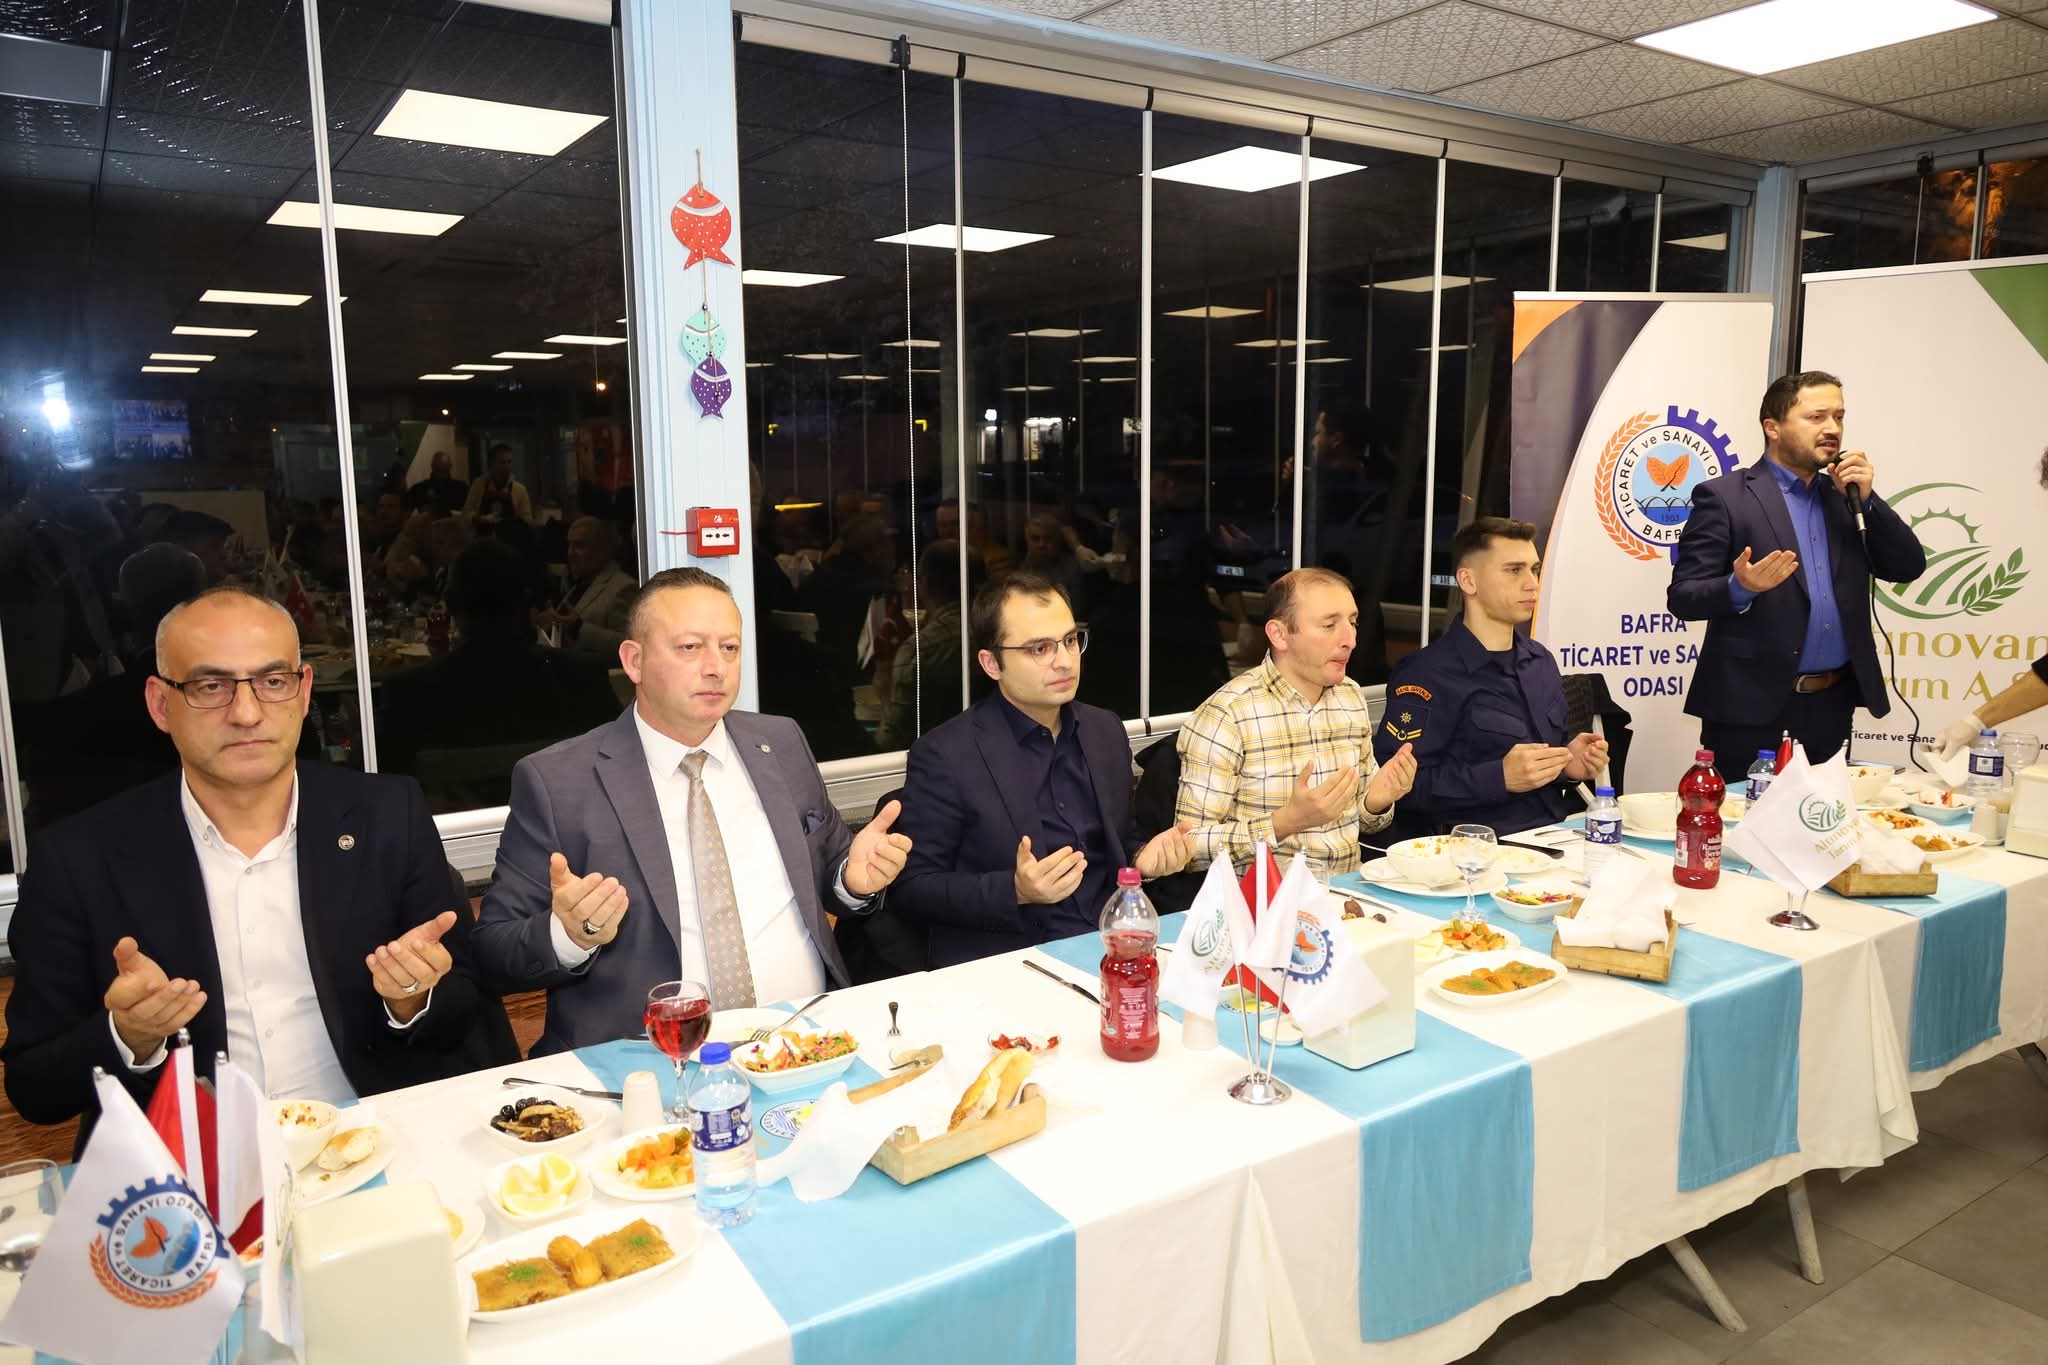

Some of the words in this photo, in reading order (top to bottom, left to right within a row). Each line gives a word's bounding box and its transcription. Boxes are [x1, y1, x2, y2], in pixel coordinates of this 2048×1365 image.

[1641, 435, 1657, 449] ve
[1621, 613, 1687, 634] BAFRA
[1560, 643, 1644, 667] TİCARET
[1649, 648, 1670, 665] ve
[1623, 676, 1683, 697] ODASI
[1891, 734, 1904, 742] ve
